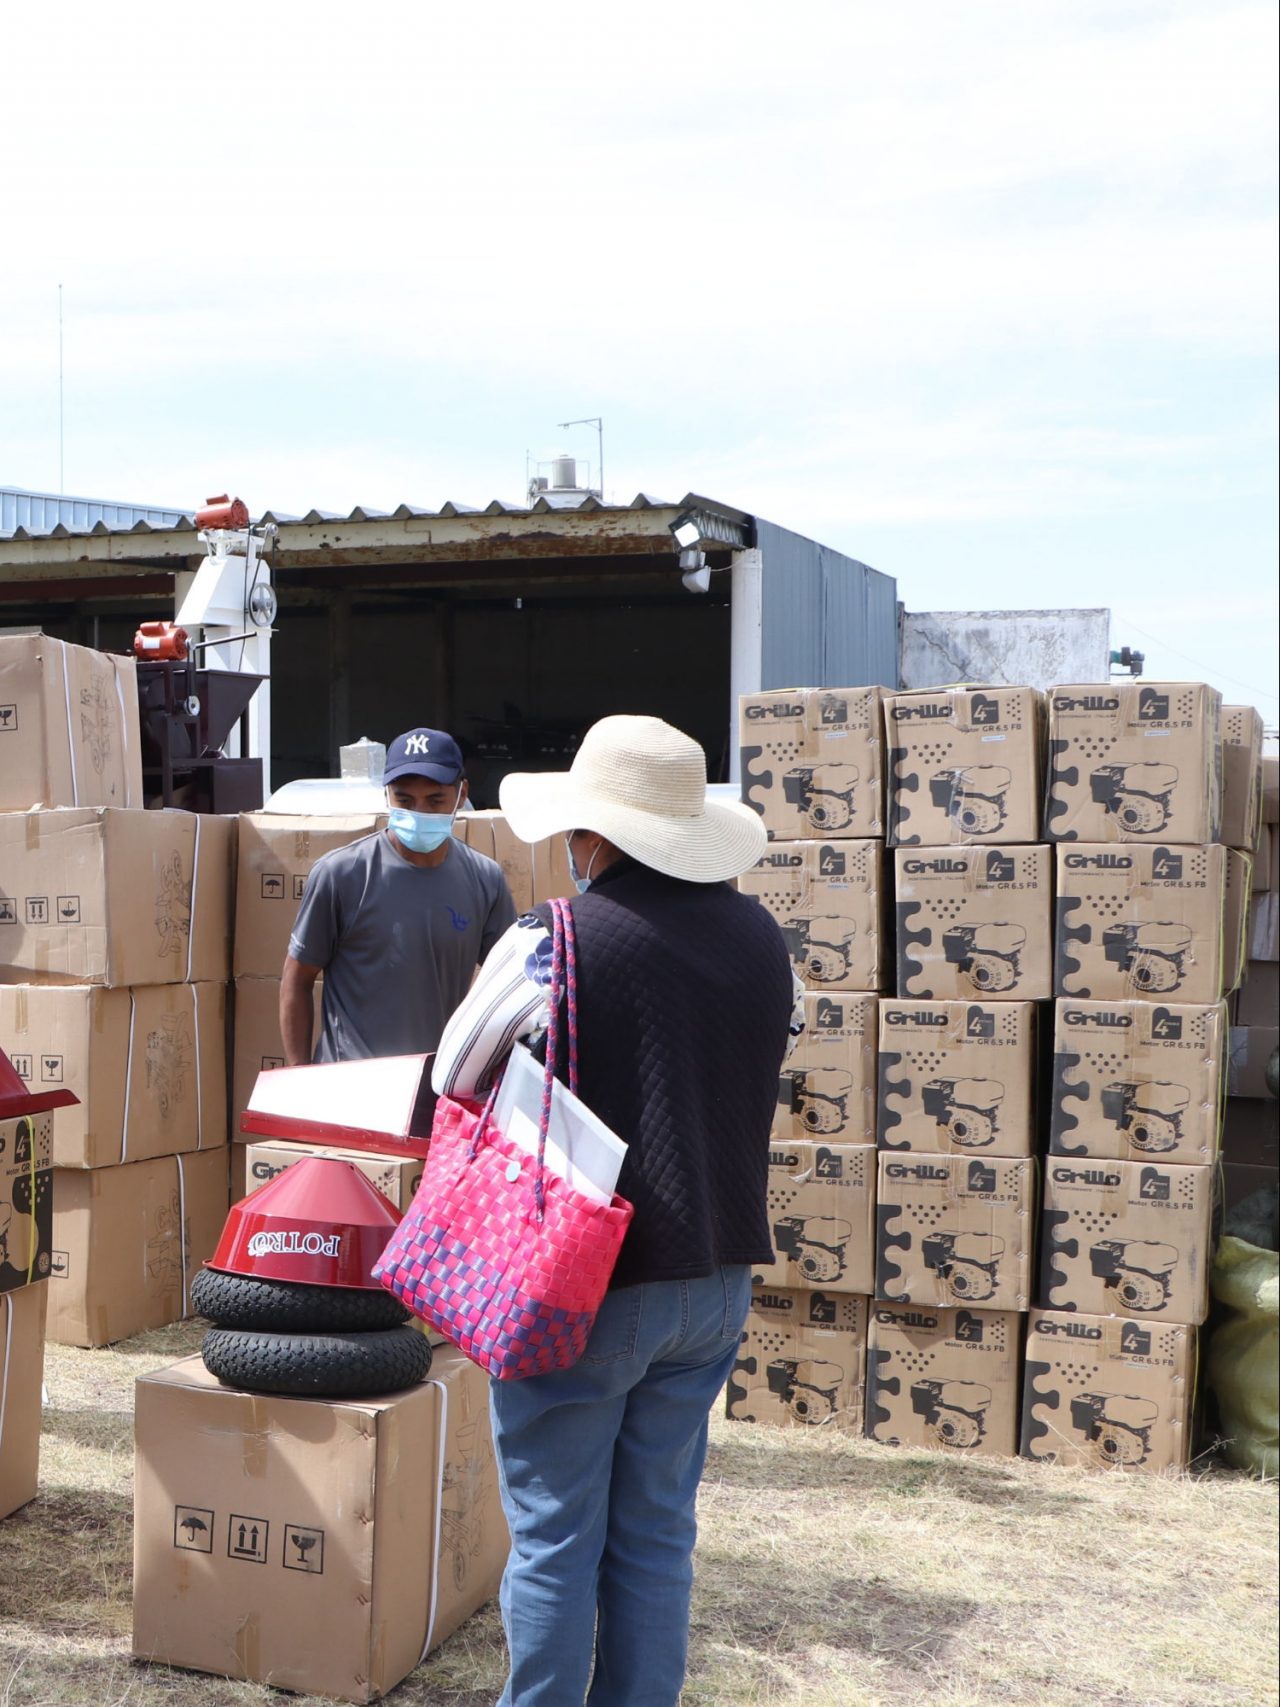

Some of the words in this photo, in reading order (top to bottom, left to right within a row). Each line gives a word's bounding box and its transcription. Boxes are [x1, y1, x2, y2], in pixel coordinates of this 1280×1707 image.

[745, 704, 804, 719] Grillo
[1053, 696, 1119, 711] Grillo
[1141, 699, 1156, 716] 4
[823, 705, 836, 720] 4
[891, 704, 952, 720] Grillo
[974, 704, 986, 721] 4
[754, 854, 802, 867] rillo
[822, 856, 834, 872] 4
[903, 859, 968, 874] Grillo
[1064, 854, 1132, 868] Grillo
[1154, 859, 1169, 876] 4
[989, 862, 1002, 878] 4
[819, 1009, 832, 1024] 4
[885, 1011, 948, 1026] Grillo
[1064, 1011, 1132, 1027] Grillo
[969, 1017, 982, 1033] 4
[1154, 1019, 1169, 1036] 4
[16, 1136, 26, 1158] 4
[21, 1164, 31, 1172] GR
[42, 1158, 50, 1166] FB
[818, 1158, 830, 1174] 4
[885, 1164, 950, 1180] Grillo
[970, 1172, 984, 1188] 4
[1052, 1168, 1121, 1186] Grillo
[1142, 1179, 1156, 1195] 4
[1182, 1202, 1194, 1210] FB
[248, 1232, 340, 1256] POTRO
[751, 1295, 792, 1310] rillo
[812, 1304, 824, 1319] 4
[875, 1310, 938, 1328] Grillo
[958, 1322, 971, 1338] 4
[1035, 1320, 1102, 1340] Grillo
[1123, 1334, 1138, 1350] 4
[1132, 1355, 1144, 1363] GR
